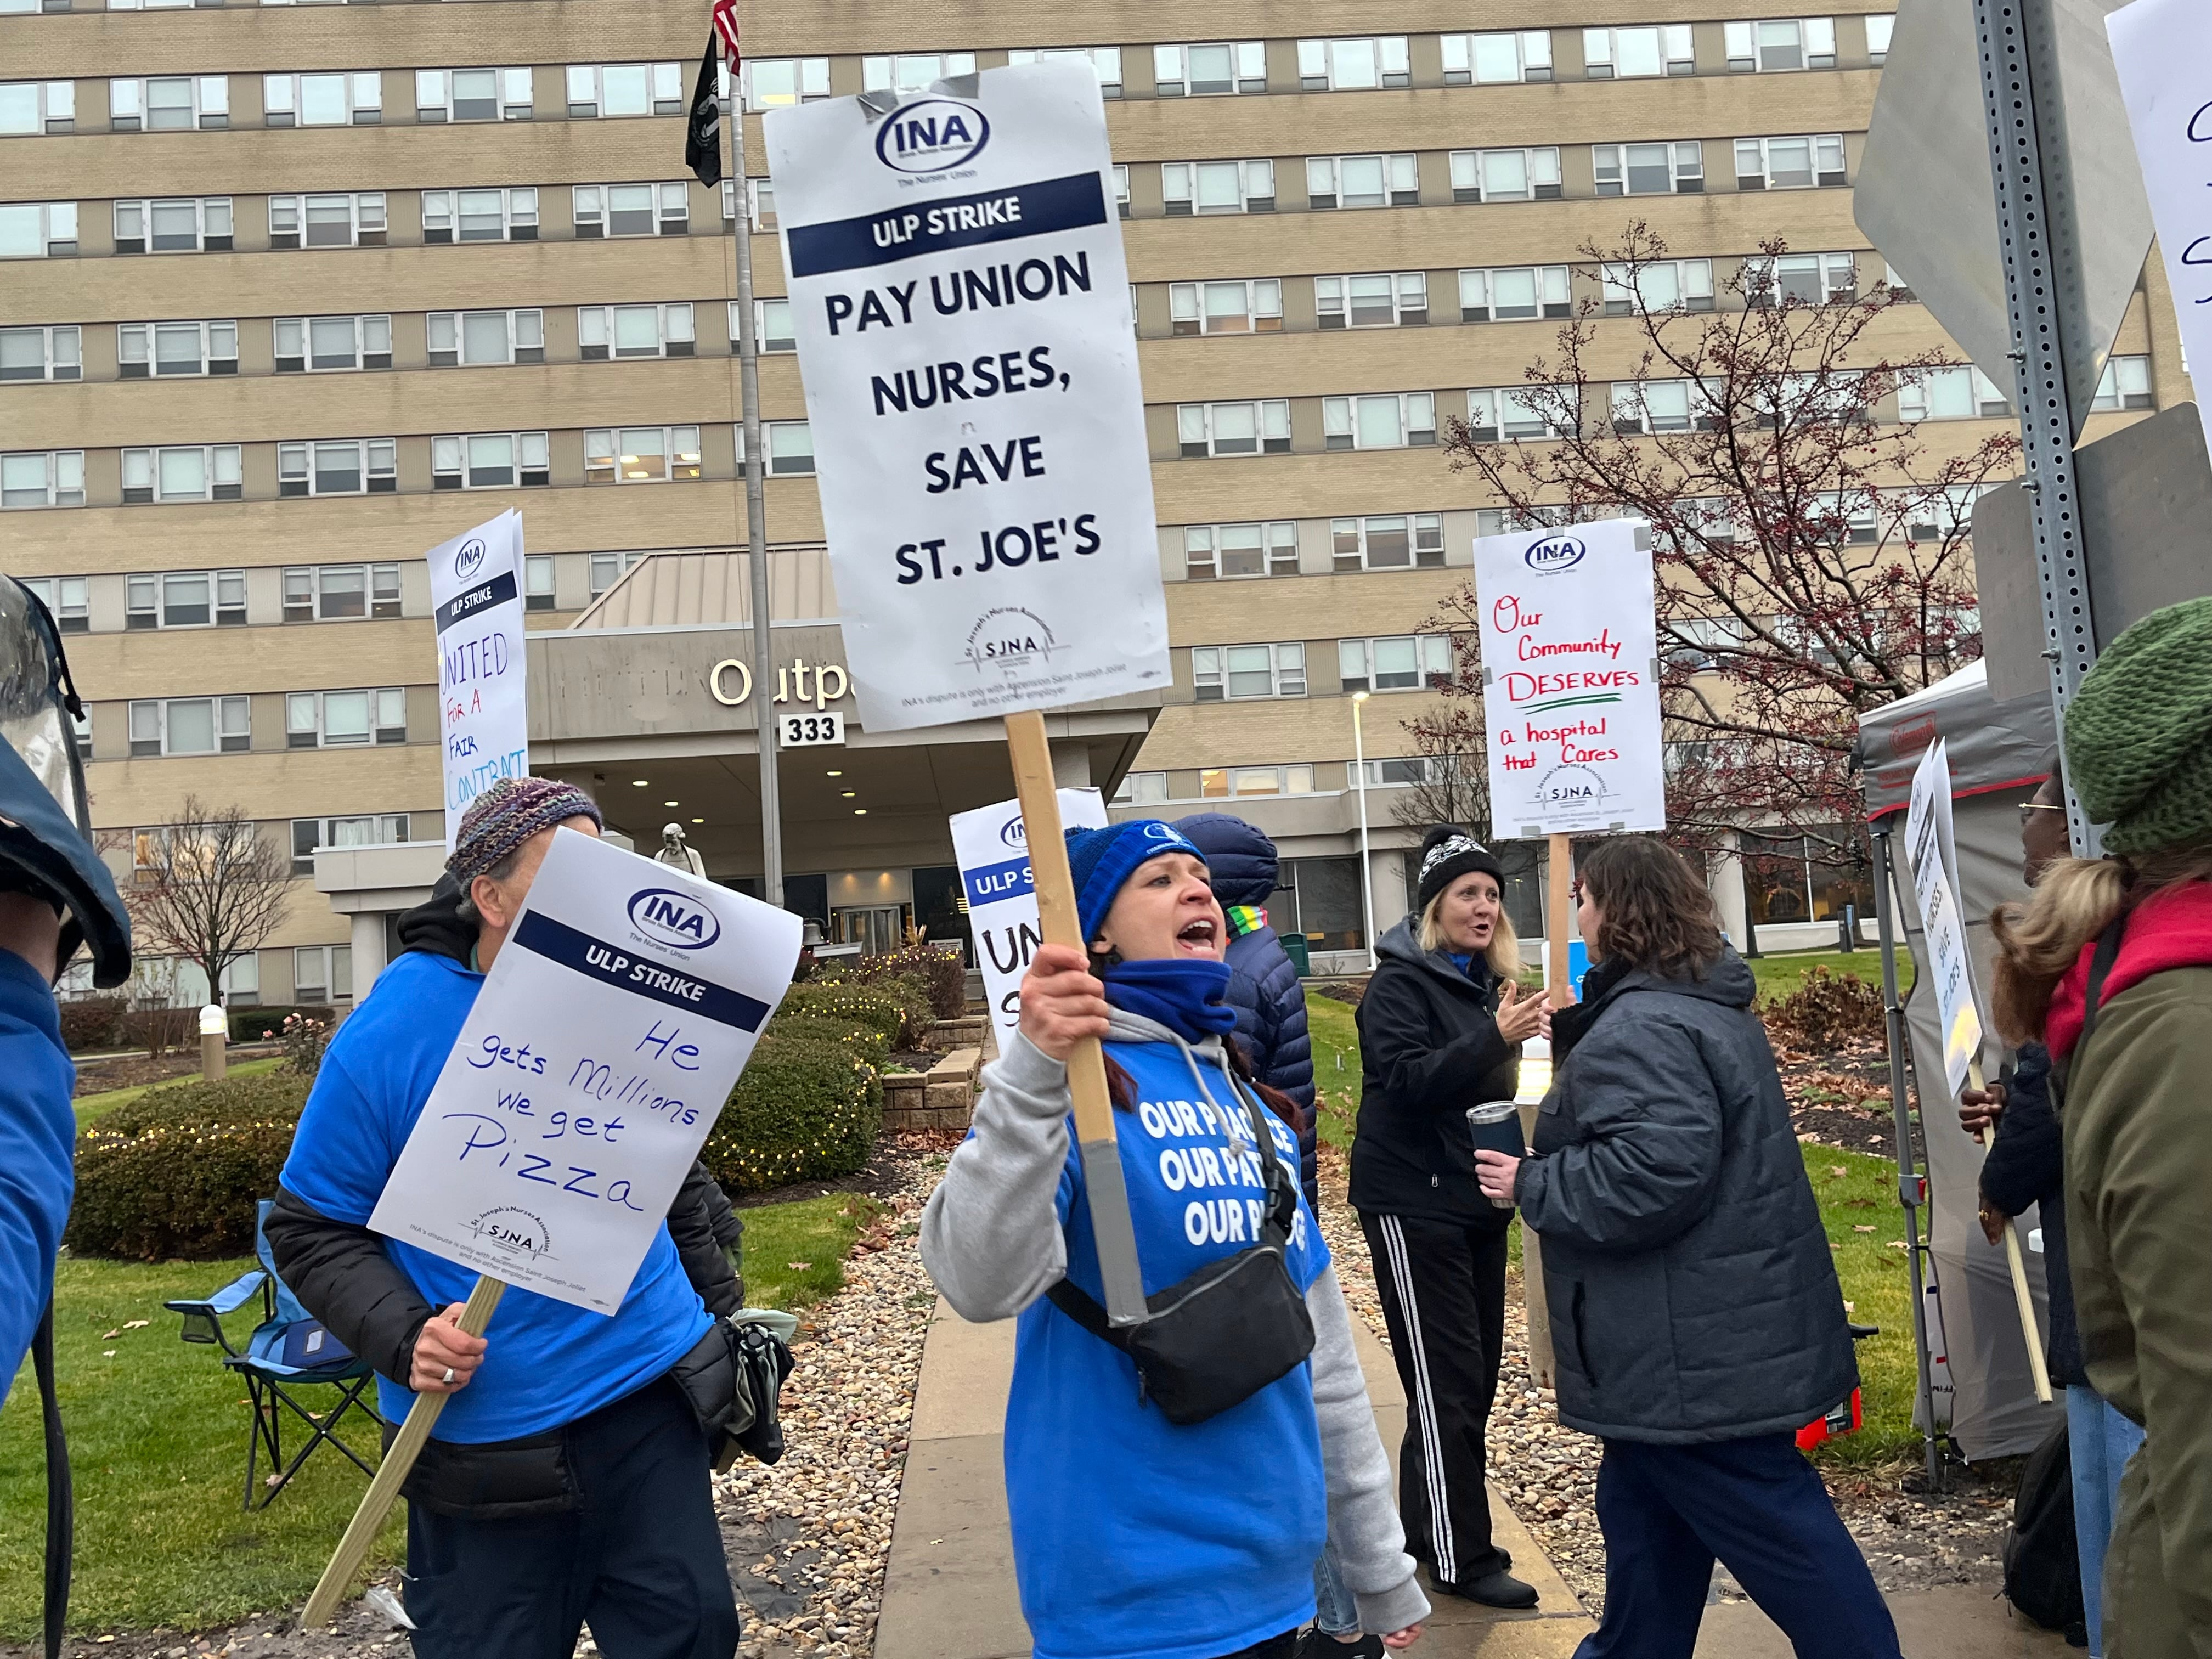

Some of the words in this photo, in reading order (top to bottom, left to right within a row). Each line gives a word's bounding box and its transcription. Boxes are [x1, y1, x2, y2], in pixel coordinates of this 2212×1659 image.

[895, 115, 973, 153] INA
[872, 214, 921, 247] ULP
[927, 196, 1022, 235] STRIKE
[825, 280, 918, 335] PAY
[931, 251, 1092, 315] UNION
[871, 346, 1070, 415] NURSES,
[925, 436, 1046, 493] SAVE
[461, 546, 480, 568] INA
[896, 539, 963, 585] ST.
[975, 514, 1101, 572] JOE'S
[1537, 542, 1576, 561] INA
[451, 600, 462, 616] ULP
[464, 586, 492, 609] STRIKE
[1493, 595, 1544, 633] Our
[985, 636, 1039, 657] SJNA
[1519, 628, 1621, 662] Community
[471, 688, 482, 714] A
[1498, 671, 1639, 702] DESERVES
[449, 733, 479, 761] FAIR
[788, 716, 836, 742] 333
[1500, 730, 1517, 746] a
[1527, 718, 1606, 746] hospital
[448, 749, 526, 810] CONTRACT
[1502, 751, 1537, 771] that
[1551, 786, 1593, 799] SJNA
[1011, 823, 1026, 839] IN
[975, 870, 1019, 895] ULP
[644, 896, 704, 939] INA
[629, 932, 642, 943] The
[670, 949, 691, 961] Union
[981, 918, 1043, 974] UN
[585, 944, 629, 975] ULP
[629, 964, 707, 1002] STRIKE
[466, 1035, 548, 1076] gets
[635, 1020, 700, 1071] He
[542, 1111, 625, 1142] get
[1139, 1100, 1204, 1139] OUR
[442, 1114, 644, 1211] Pizza
[1159, 1147, 1226, 1192] OUR
[488, 1225, 533, 1249] SJNA
[510, 1206, 535, 1219] Nurses
[534, 1217, 551, 1252] Association
[1184, 1199, 1246, 1246] OUR
[427, 1232, 453, 1245] dispute
[460, 1244, 476, 1254] only
[476, 1250, 490, 1260] with
[491, 1256, 524, 1272] Ascension
[525, 1267, 543, 1278] Saint
[543, 1273, 567, 1286] Joseph
[567, 1282, 586, 1293] Joliet
[459, 1251, 472, 1260] and
[482, 1261, 501, 1271] other
[501, 1268, 533, 1283] employer
